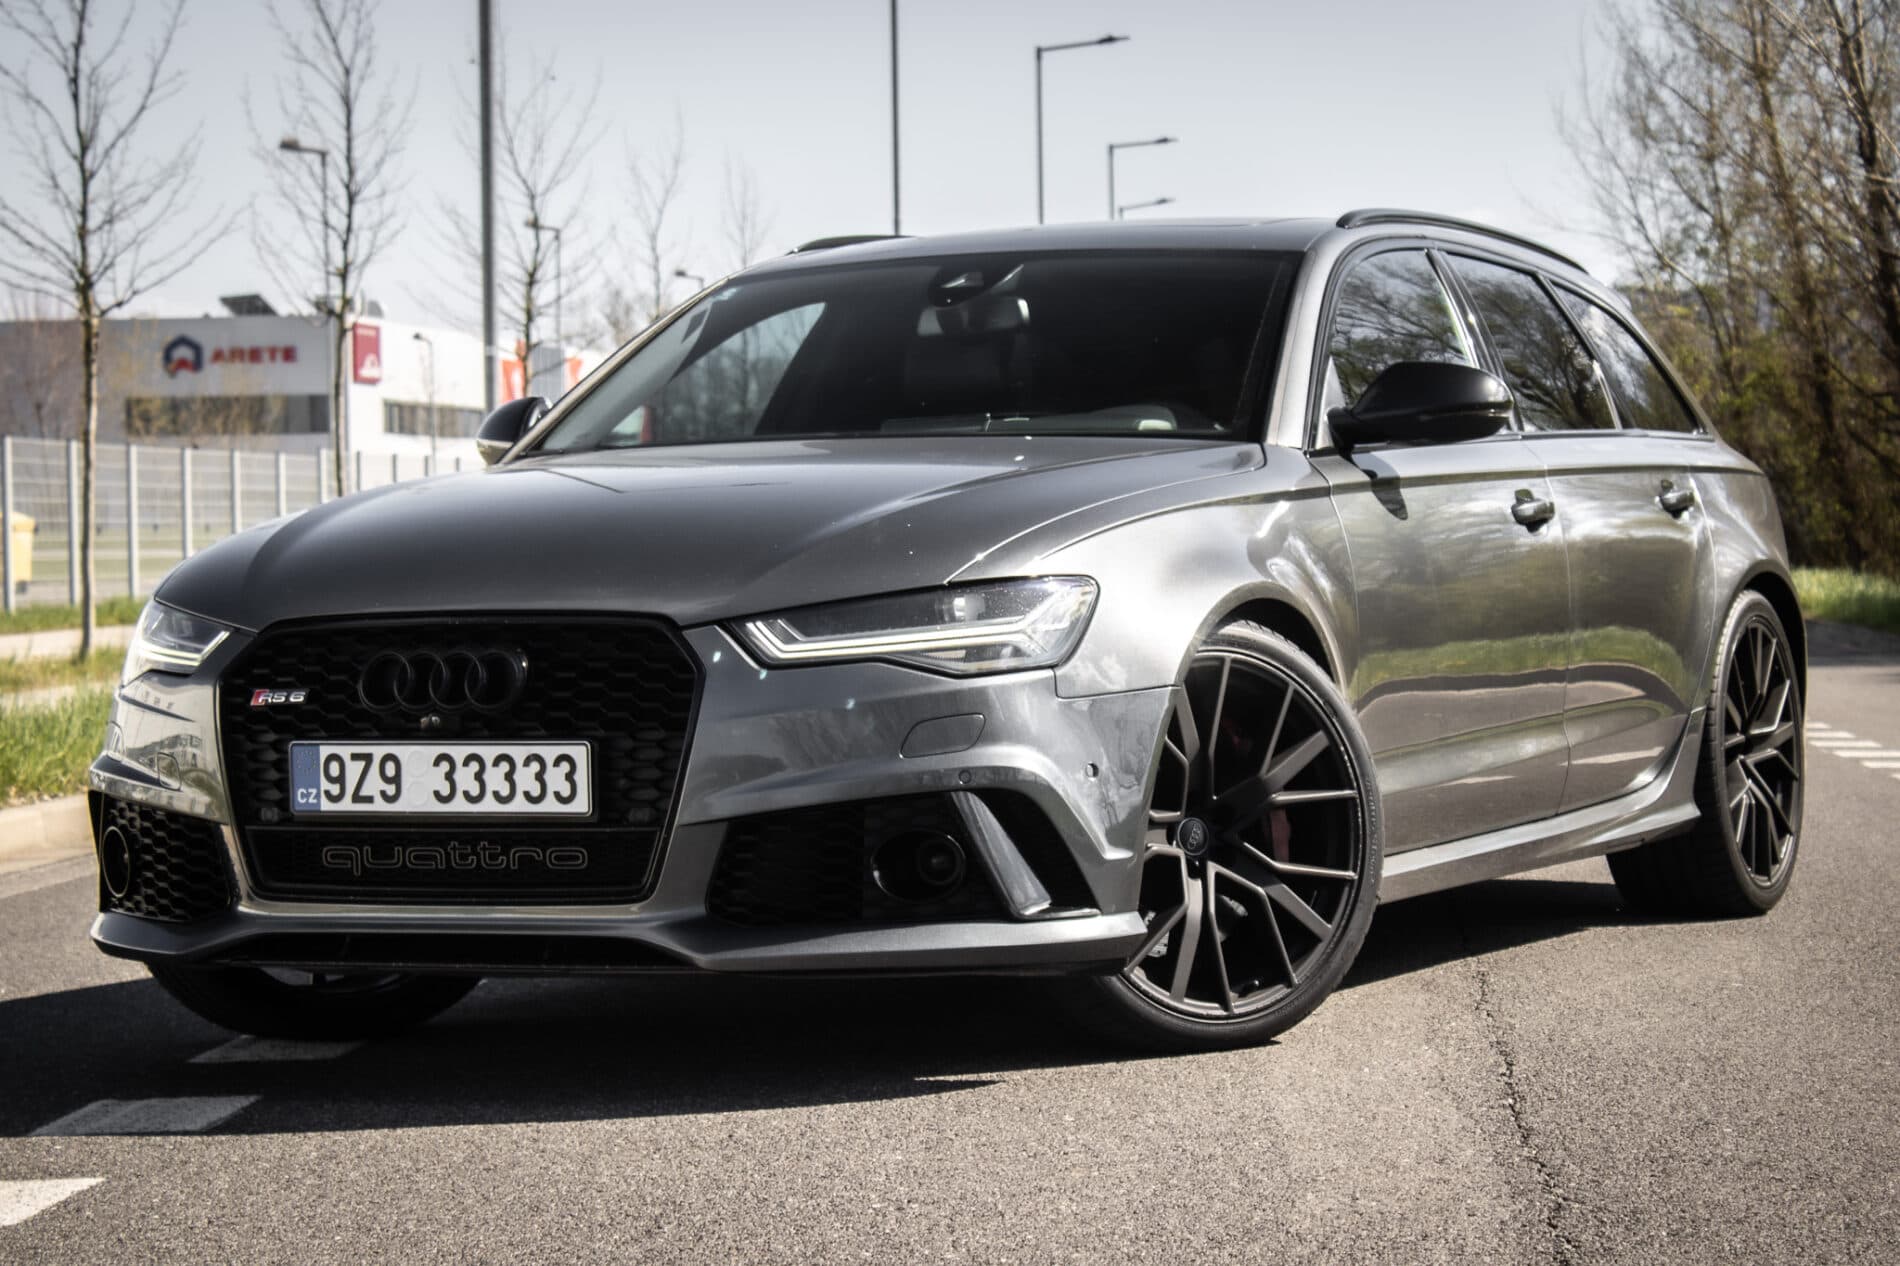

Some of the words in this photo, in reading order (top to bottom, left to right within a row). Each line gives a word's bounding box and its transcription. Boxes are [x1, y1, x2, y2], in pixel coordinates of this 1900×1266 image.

[211, 345, 297, 364] ARETE
[322, 752, 402, 804] 9Z9
[432, 752, 578, 805] 33333
[297, 788, 318, 803] CZ
[322, 841, 589, 877] quattro
